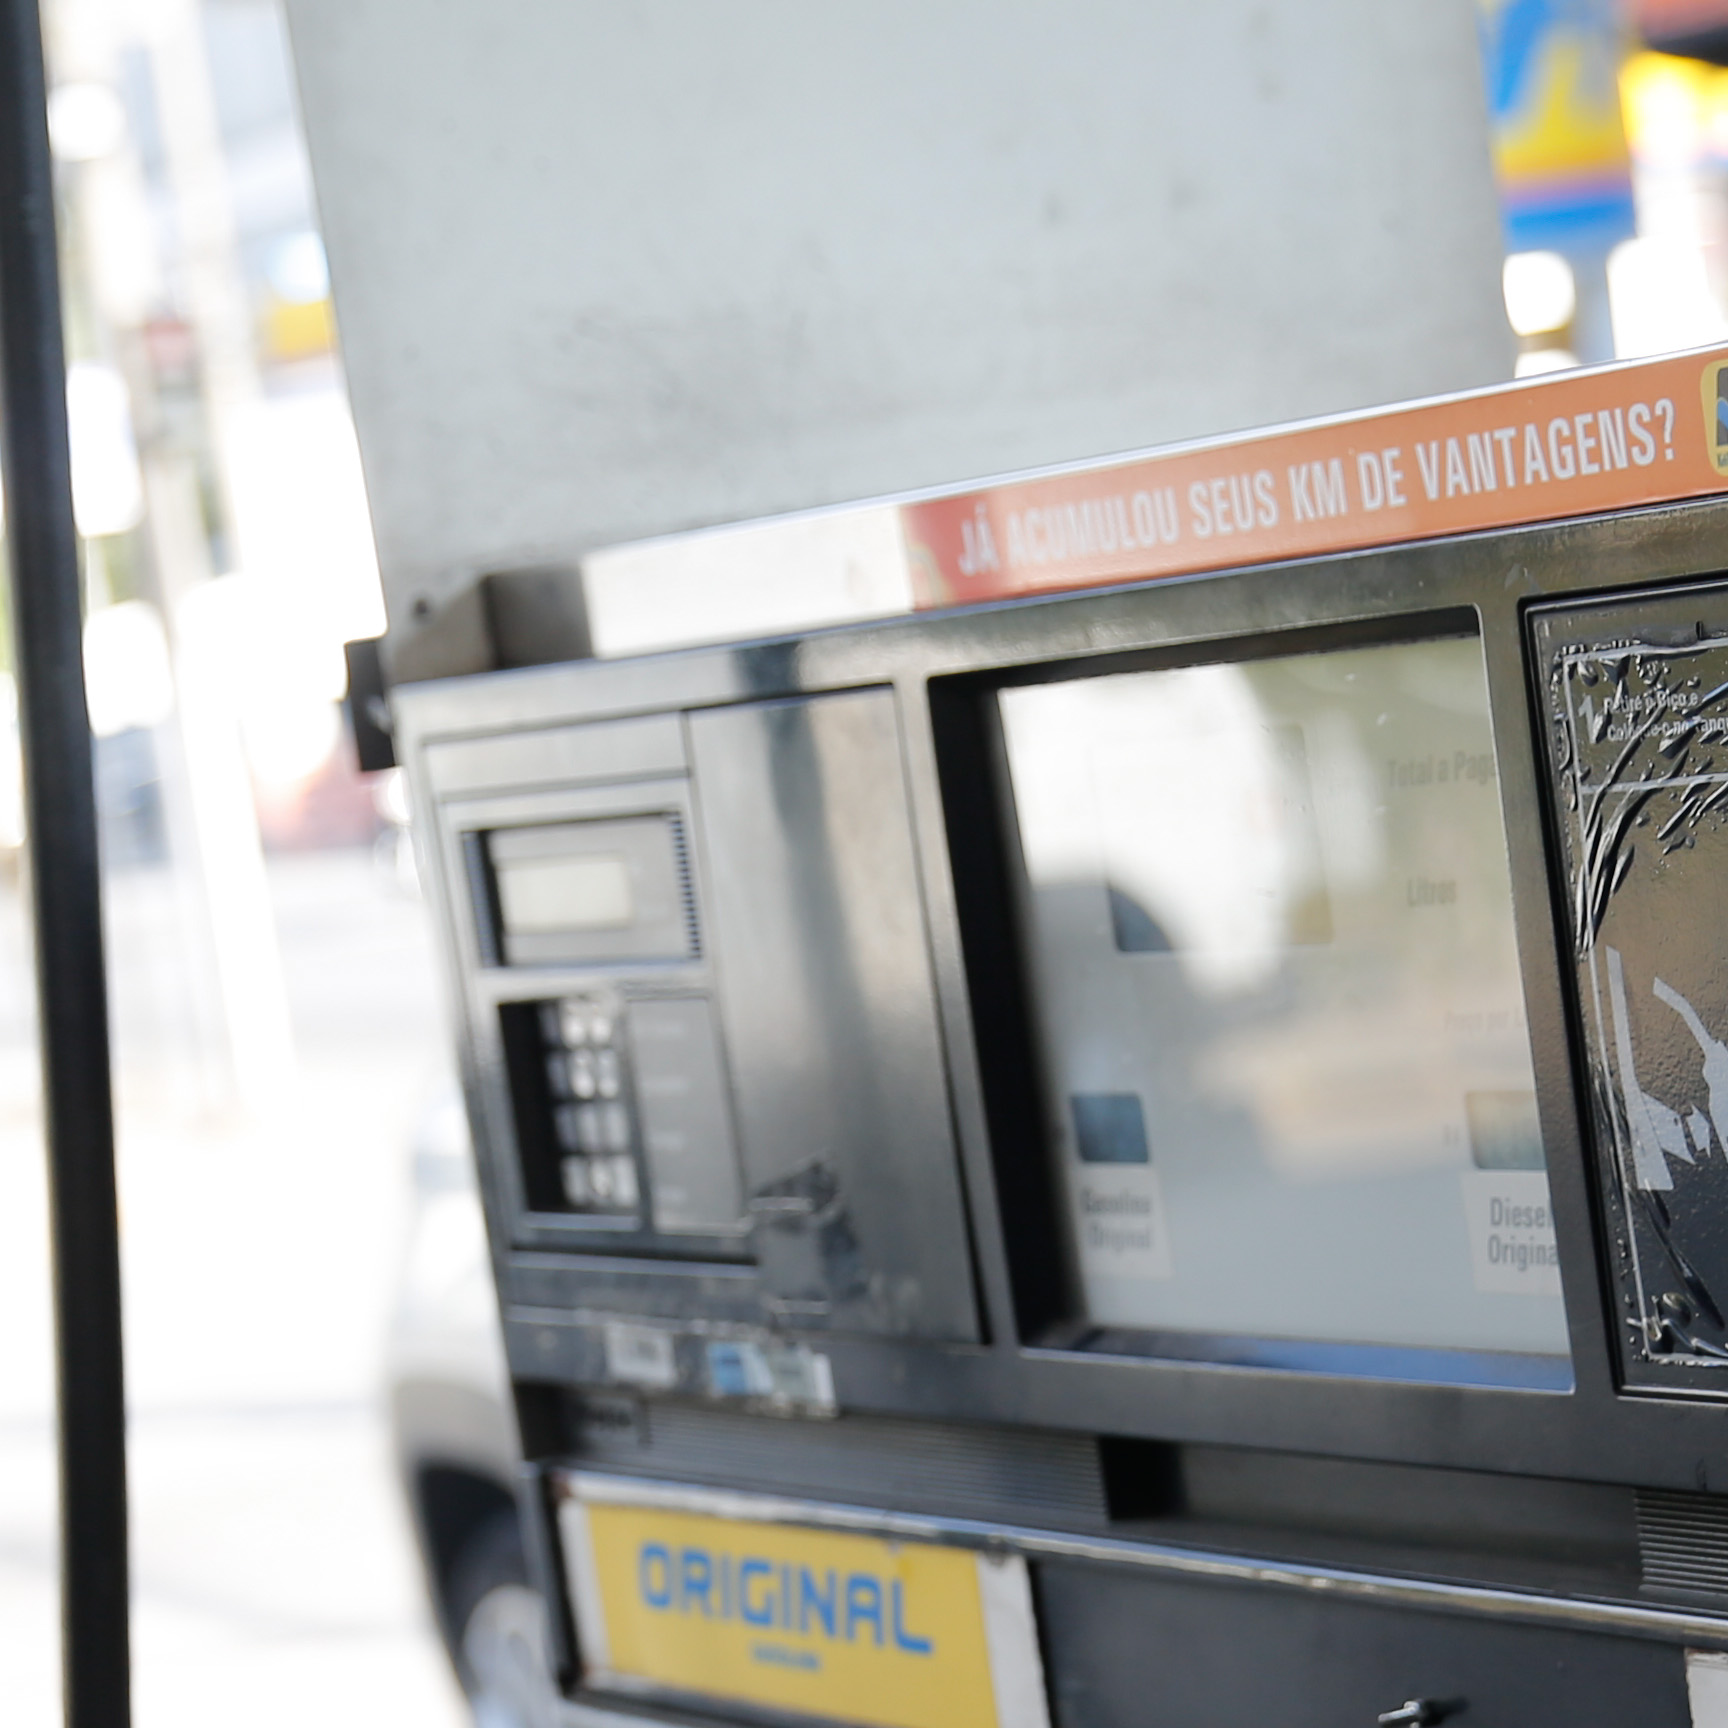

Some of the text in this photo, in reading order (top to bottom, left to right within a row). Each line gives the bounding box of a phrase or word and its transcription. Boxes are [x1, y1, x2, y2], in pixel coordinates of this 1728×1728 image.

[956, 398, 1677, 577] JÁ ACUMULOU SEUS KM DE VANTAGENS?
[1578, 693, 1599, 744] 1
[638, 1542, 935, 1656] ORIGINAL
